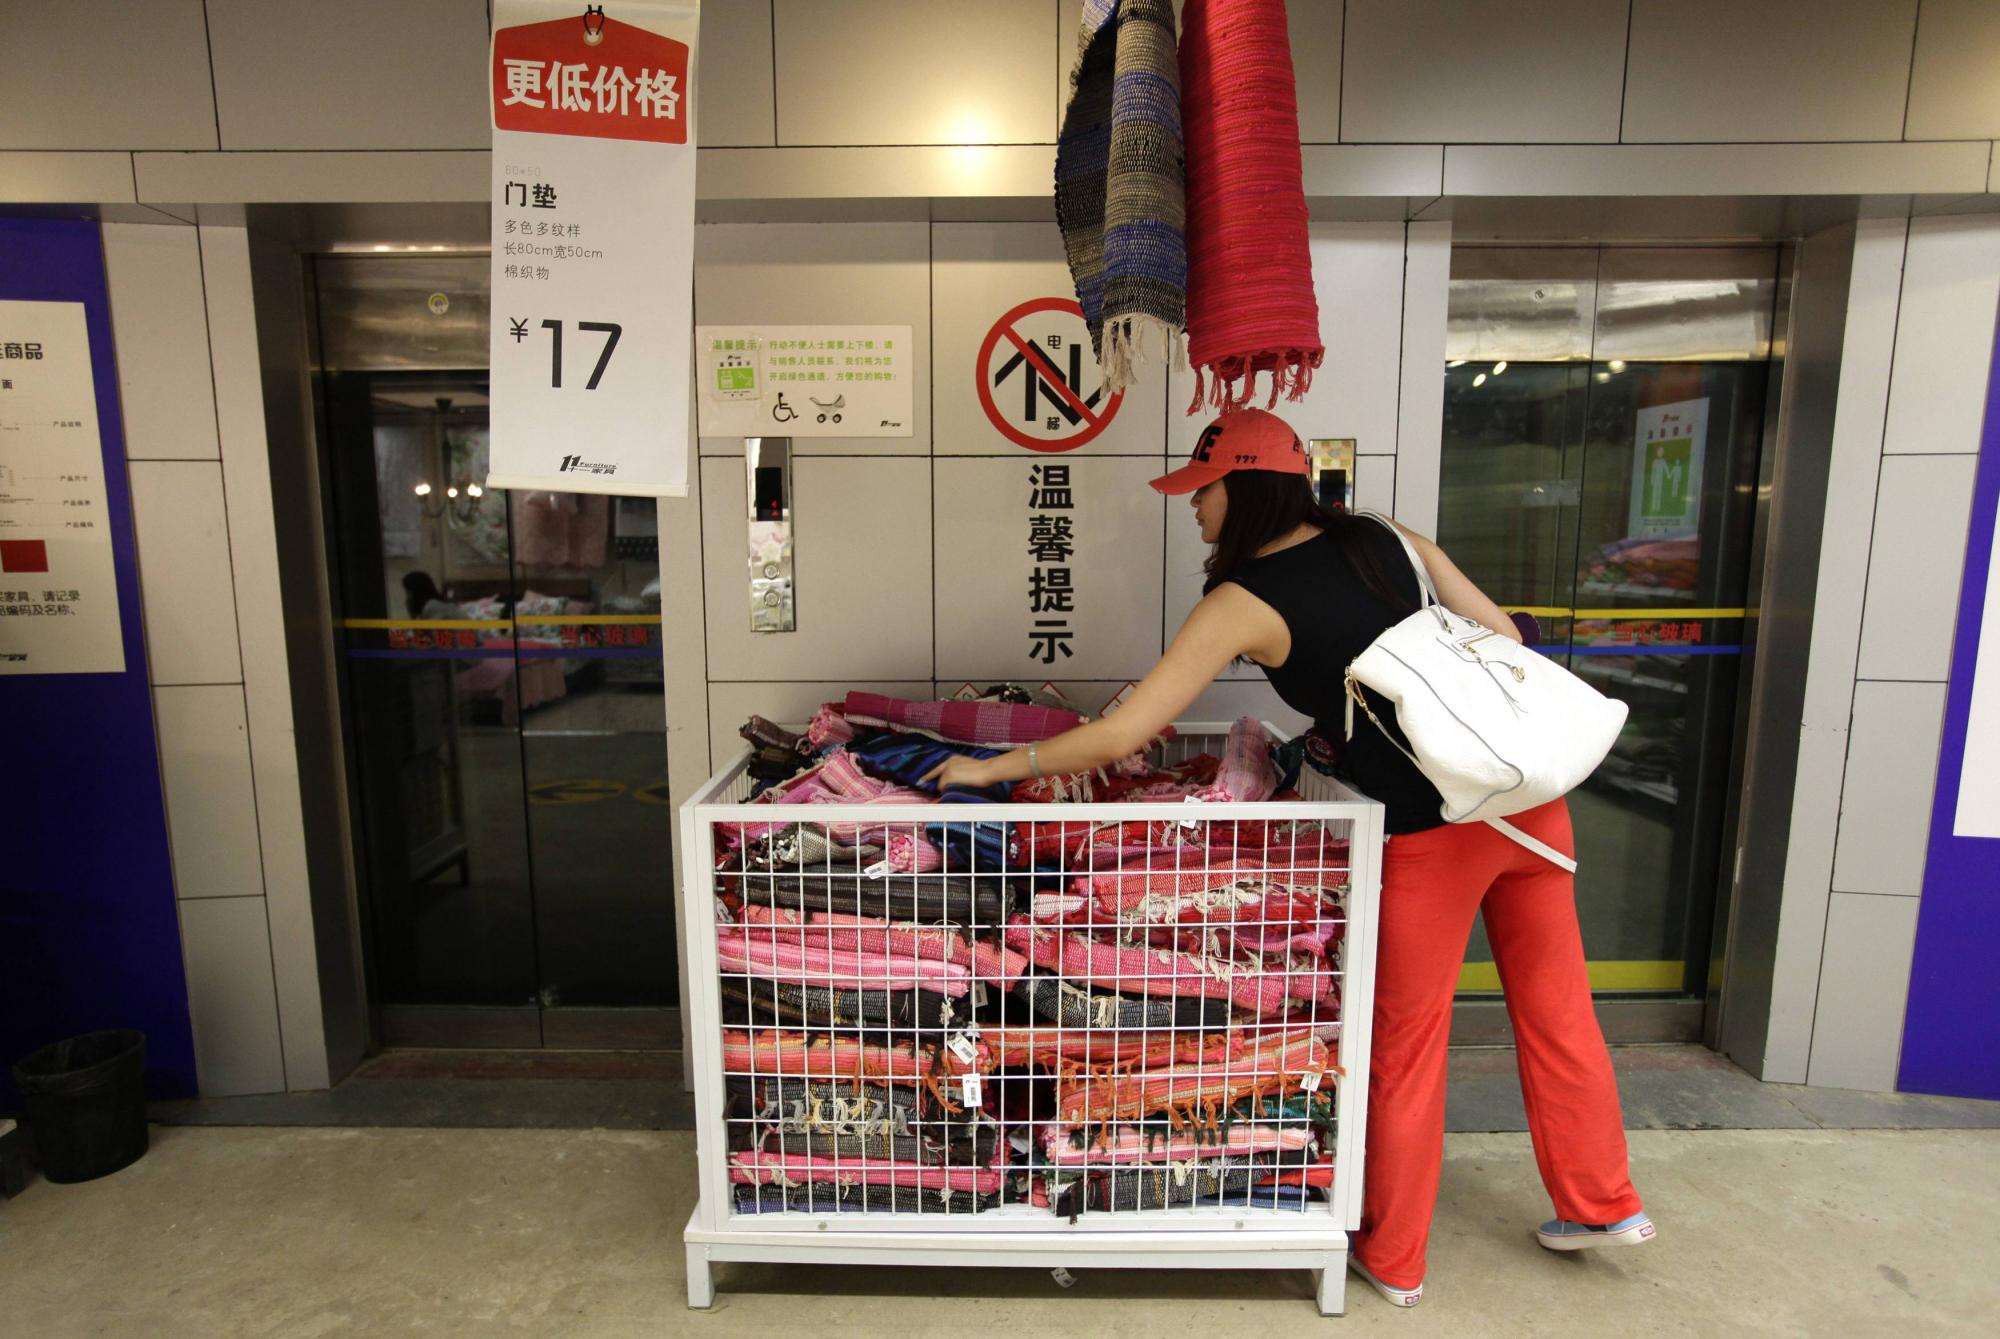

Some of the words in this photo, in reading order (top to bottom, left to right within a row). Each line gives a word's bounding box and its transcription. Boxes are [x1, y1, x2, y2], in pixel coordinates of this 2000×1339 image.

[502, 58, 680, 120] 更低价格
[505, 181, 557, 209] 门垫
[504, 219, 581, 238] 多色多纹样
[504, 241, 603, 259] 长80cm宽50cm
[504, 264, 550, 281] 棉织物
[0, 342, 44, 360] 商品
[1047, 334, 1062, 350] 电
[1046, 416, 1060, 430] 梯
[1027, 464, 1075, 664] 温馨提示
[0, 590, 80, 602] 家具，请记录
[561, 623, 649, 649] 当心玻璃
[1615, 623, 1702, 643] 当心玻璃
